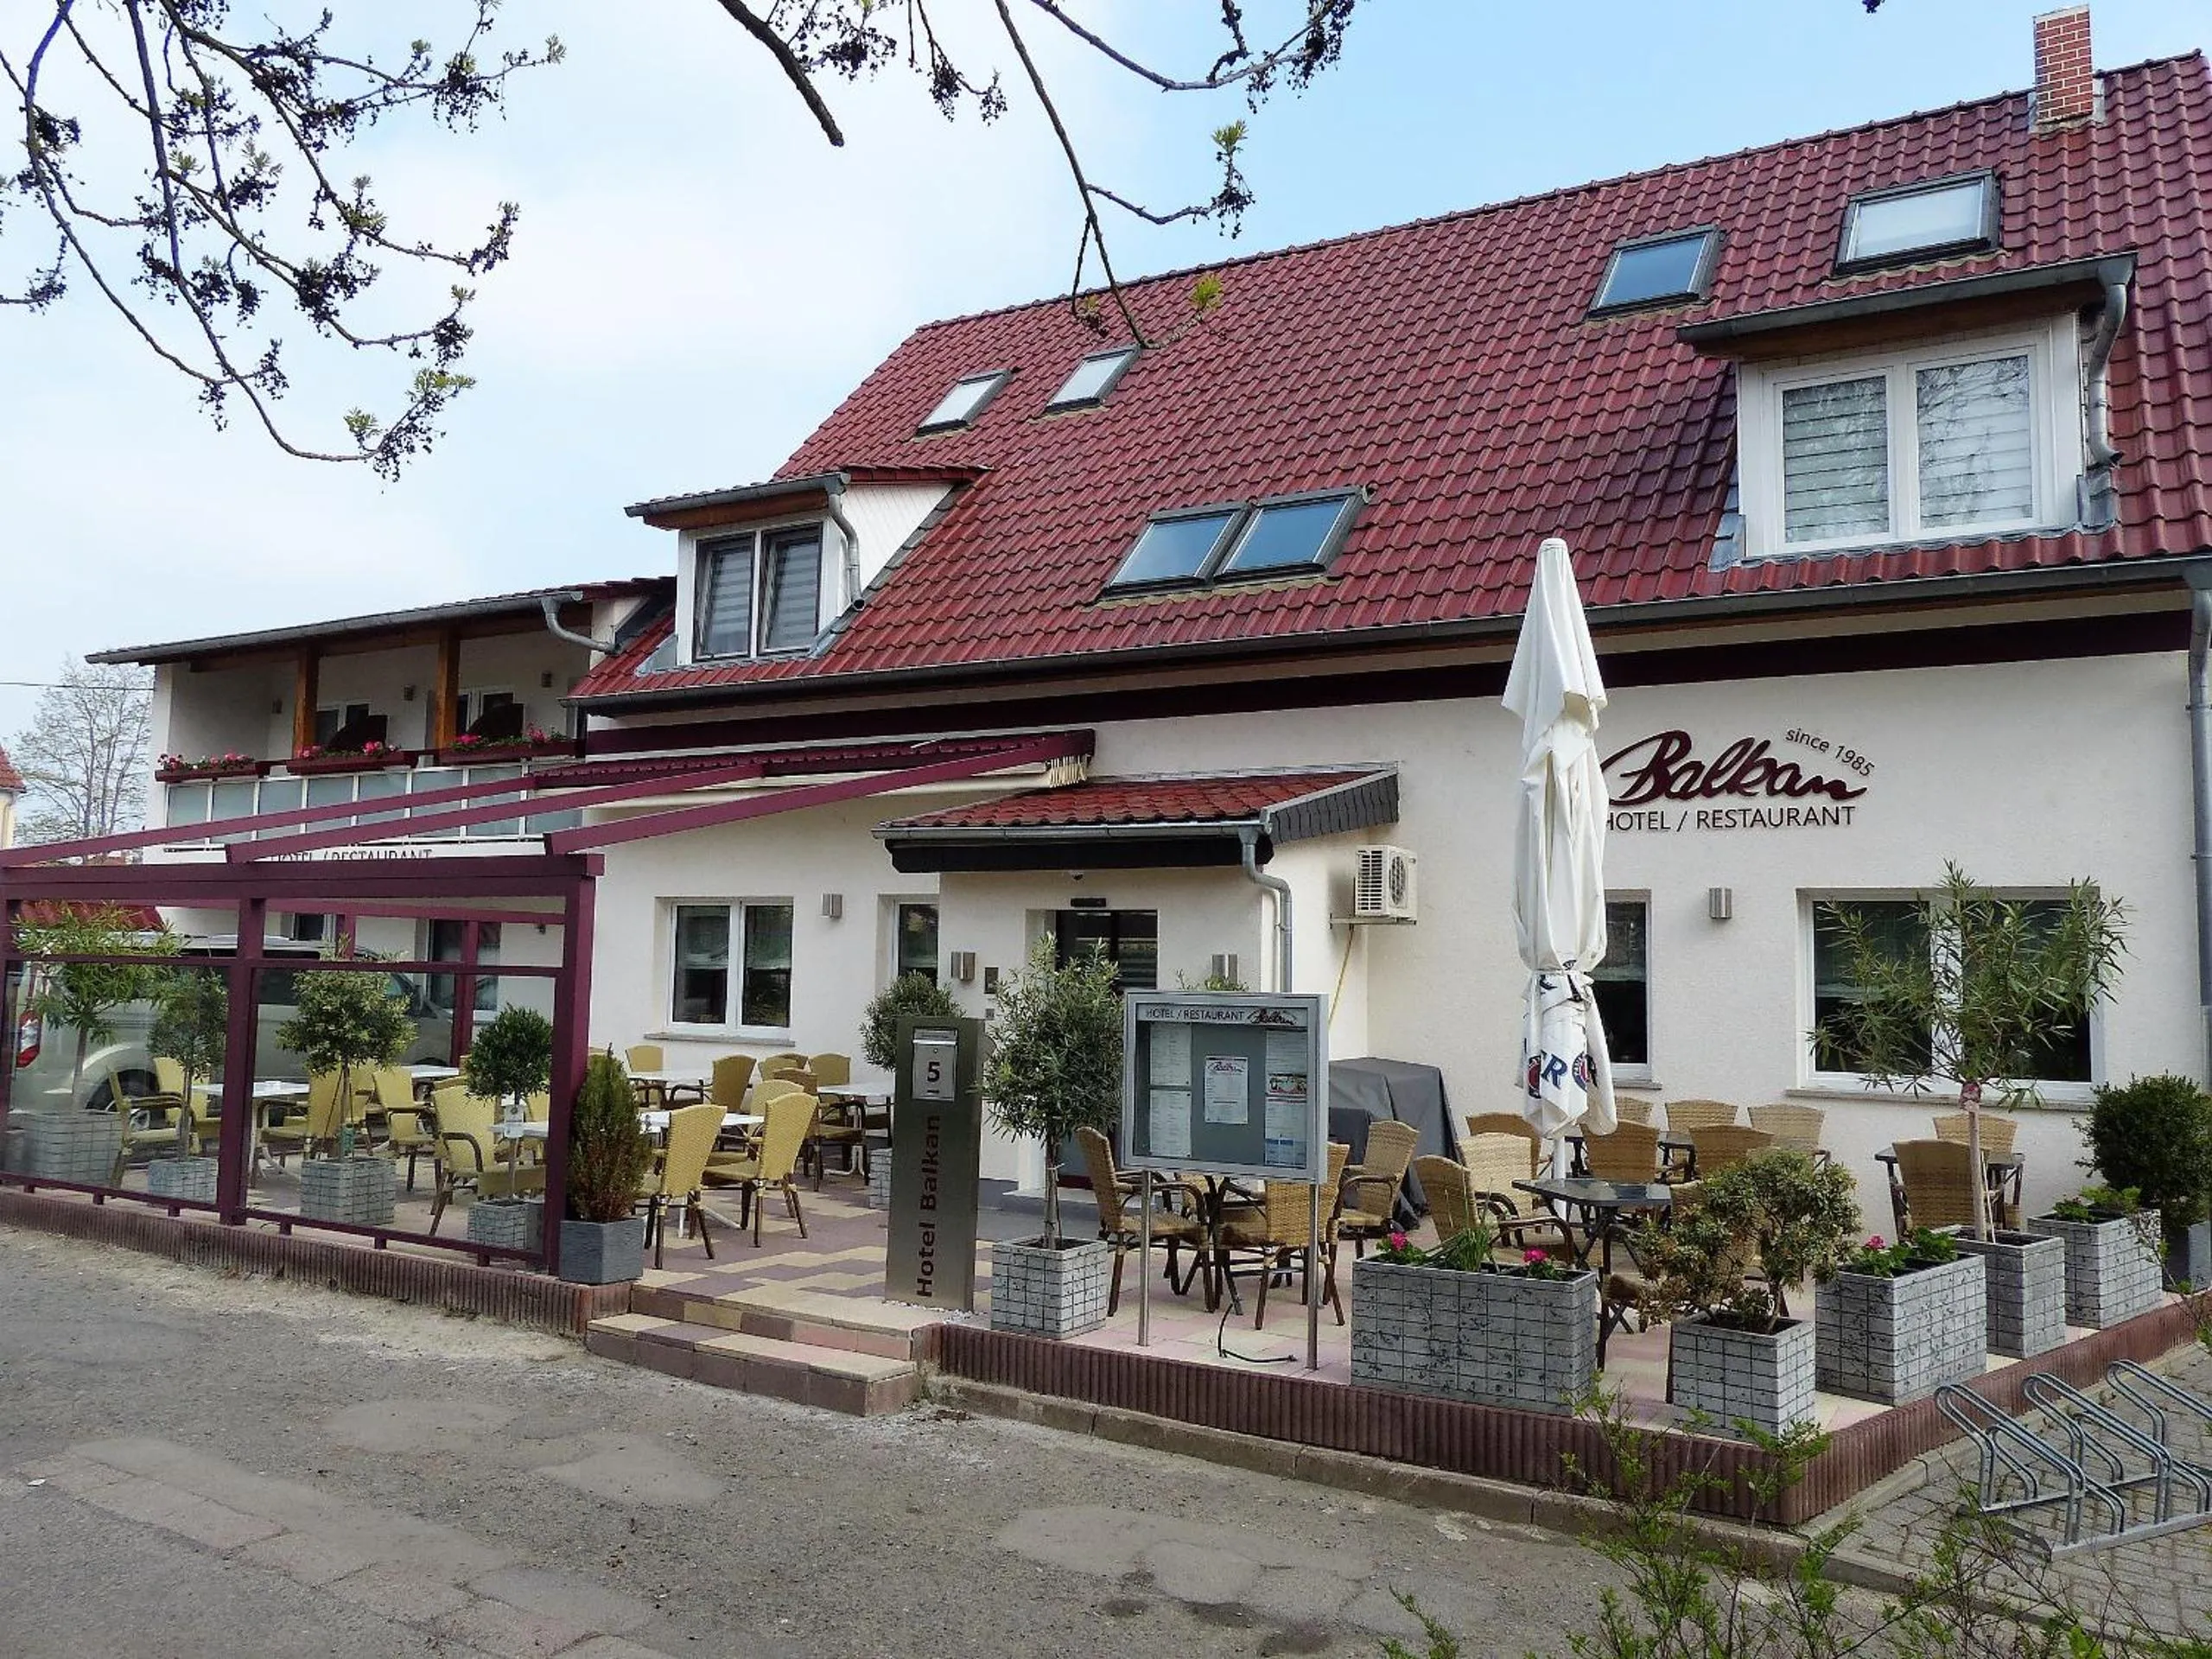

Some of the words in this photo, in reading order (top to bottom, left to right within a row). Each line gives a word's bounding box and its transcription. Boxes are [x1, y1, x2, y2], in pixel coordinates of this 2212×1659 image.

[1601, 730, 1867, 805] Balkan
[1785, 728, 1829, 753] since
[1835, 746, 1875, 776] 1985
[1607, 811, 1671, 830] HOTEL
[1696, 806, 1855, 830] RESTAURANT
[1147, 1008, 1173, 1018] HOTEL
[1184, 1009, 1244, 1020] RESTAURANT
[927, 1061, 941, 1083] 5
[919, 1115, 941, 1211] Balkan
[916, 1223, 936, 1297] Hotel
